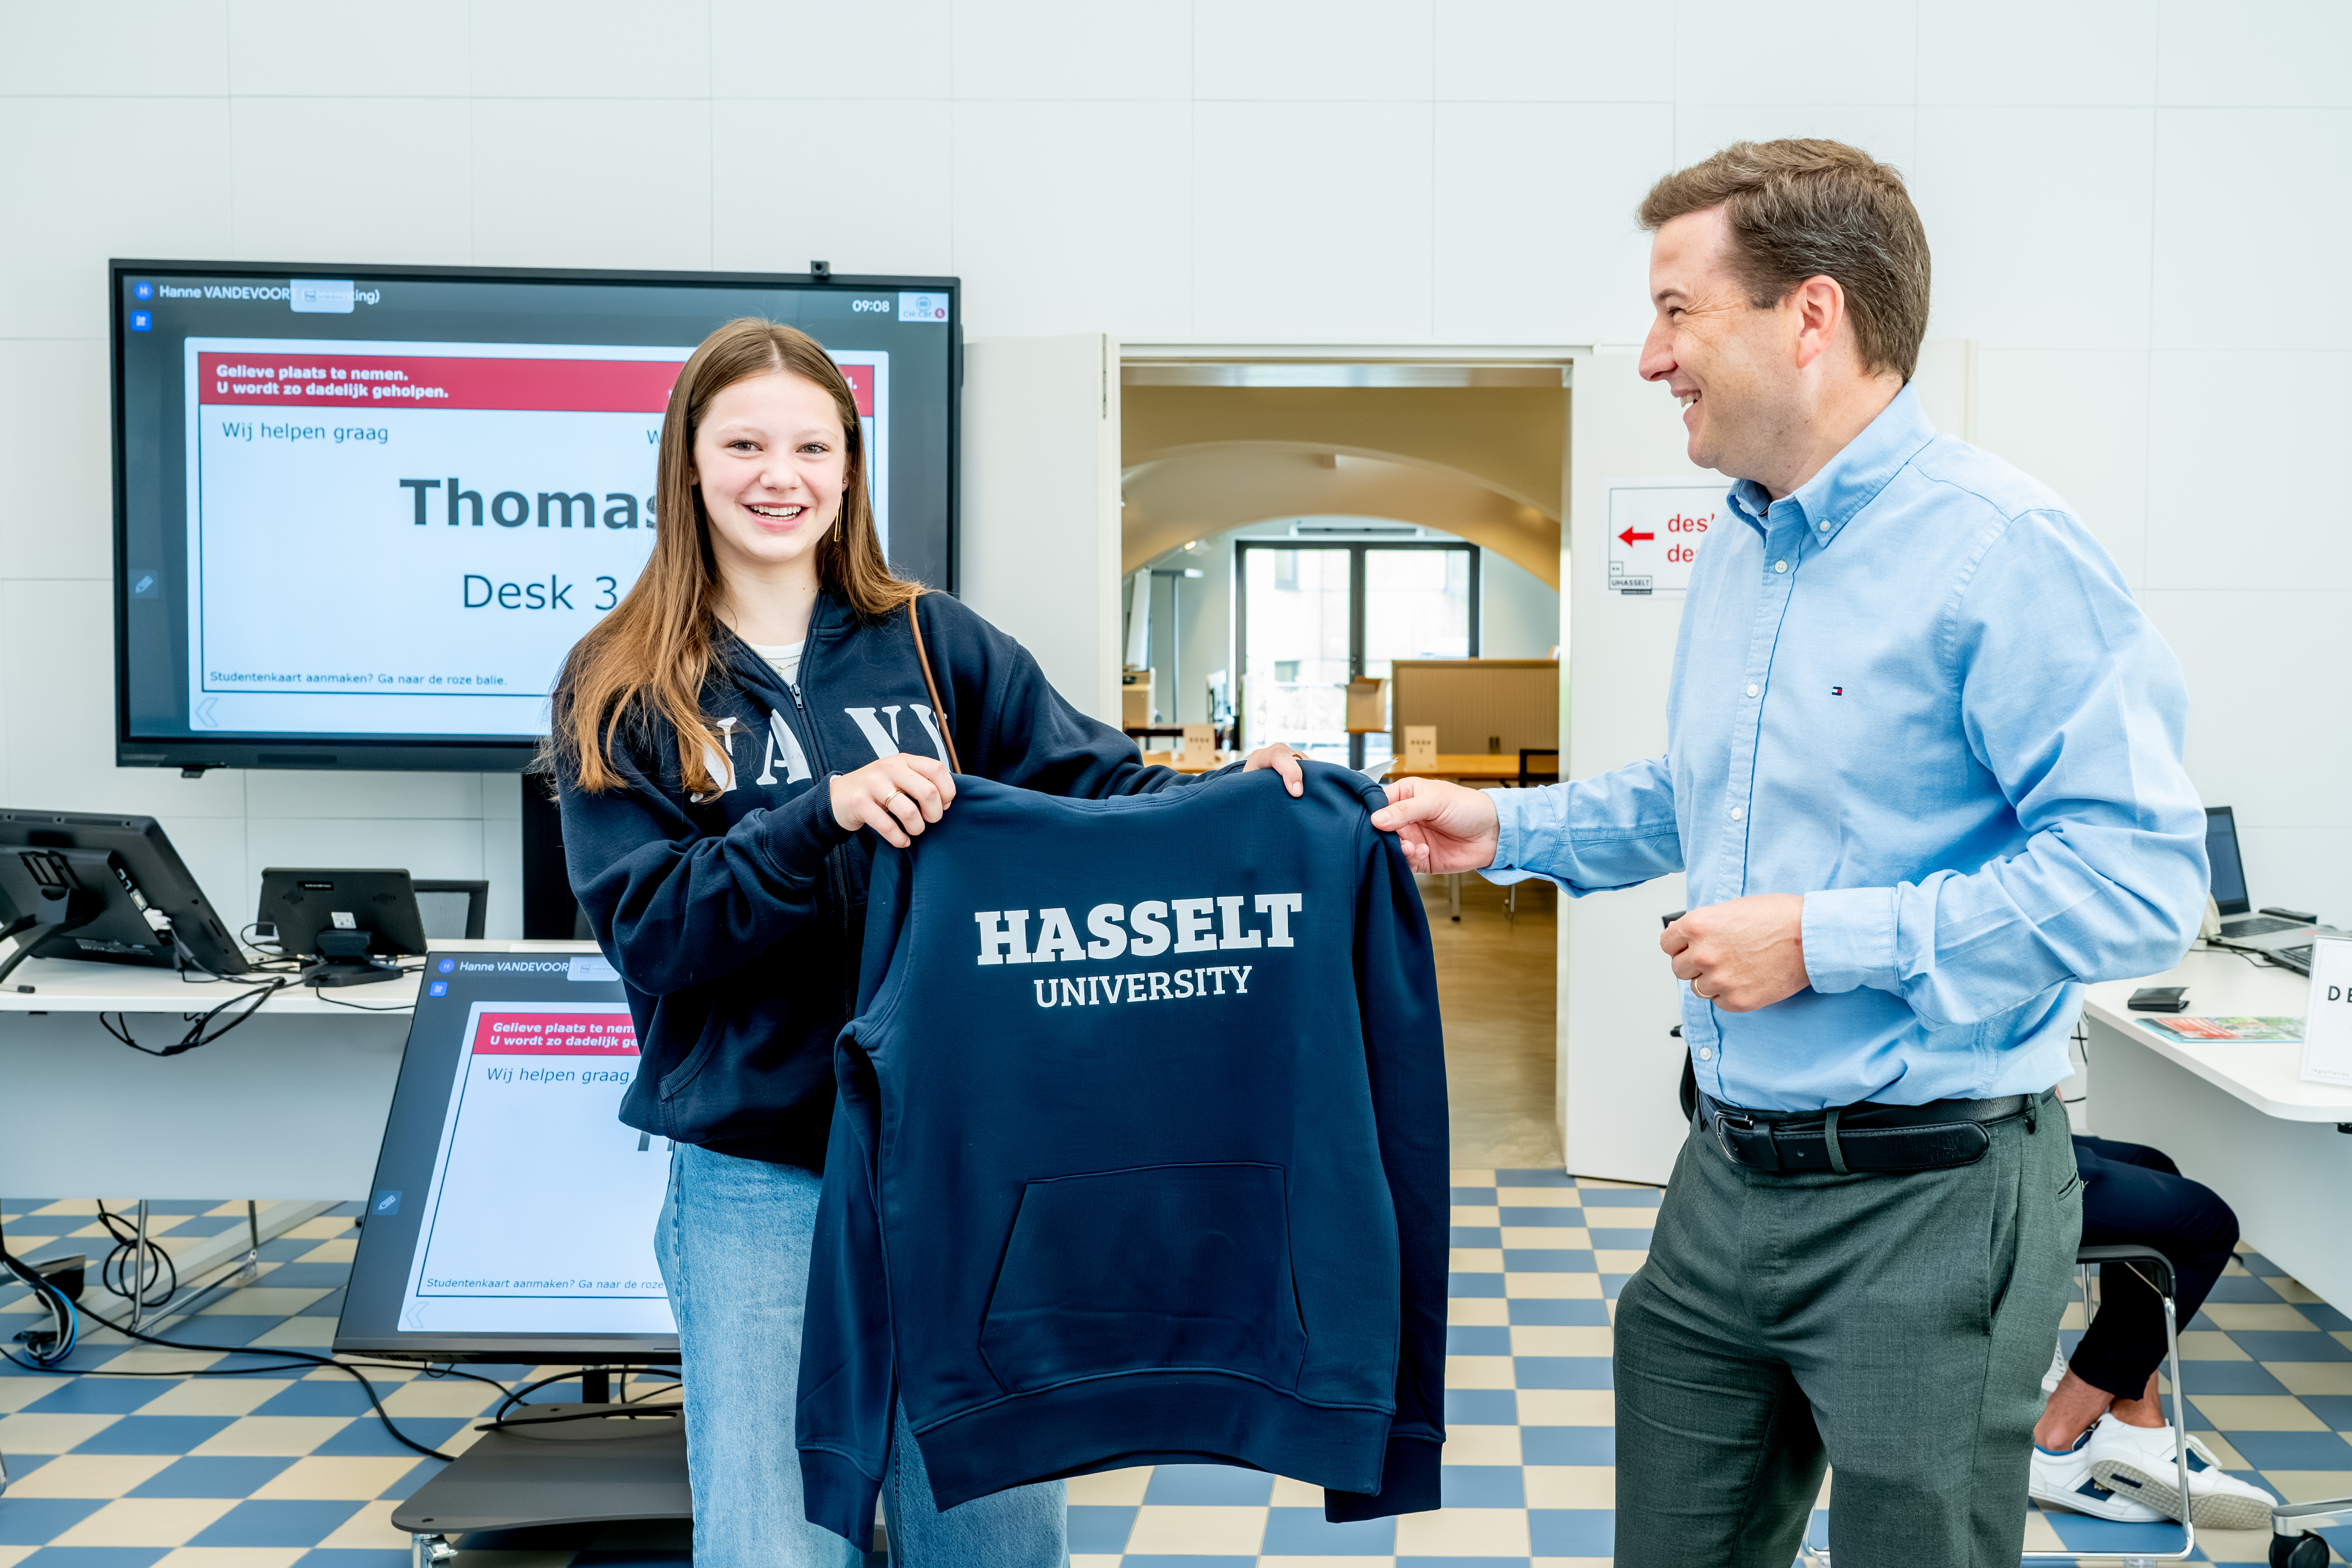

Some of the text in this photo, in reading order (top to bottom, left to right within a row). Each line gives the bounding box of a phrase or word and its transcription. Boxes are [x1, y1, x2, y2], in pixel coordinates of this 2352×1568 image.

[160, 285, 201, 299] Hanne
[204, 286, 298, 300] VANDEVOORT
[852, 300, 890, 313] 09:08
[216, 364, 409, 381] Gelieve plaats te nemen.
[216, 382, 449, 400] U wordt zo dadelijk geholpen.
[222, 422, 388, 444] Wij helpen graag
[1667, 544, 1699, 562] de
[464, 574, 618, 611] Desk 3
[210, 671, 507, 686] Studentenkaart aanmaken? Ga naar de roze balie.
[974, 893, 1302, 965] HASSELT
[459, 962, 495, 972] Hanne
[497, 962, 575, 972] VANDEVOORT
[1034, 966, 1252, 1008] UNIVERSITY
[493, 1023, 542, 1033] Gelieve
[545, 1023, 585, 1034] plaats
[590, 1024, 603, 1033] te
[490, 1036, 500, 1045] U
[504, 1036, 543, 1046] wordt
[546, 1038, 562, 1046] zo
[566, 1036, 618, 1048] dadelijk
[488, 1067, 629, 1084] Wij helpen graag
[427, 1278, 511, 1288] Studentenkaart
[513, 1279, 575, 1288] aanmaken?
[579, 1279, 593, 1288] Ga
[625, 1279, 637, 1289] de
